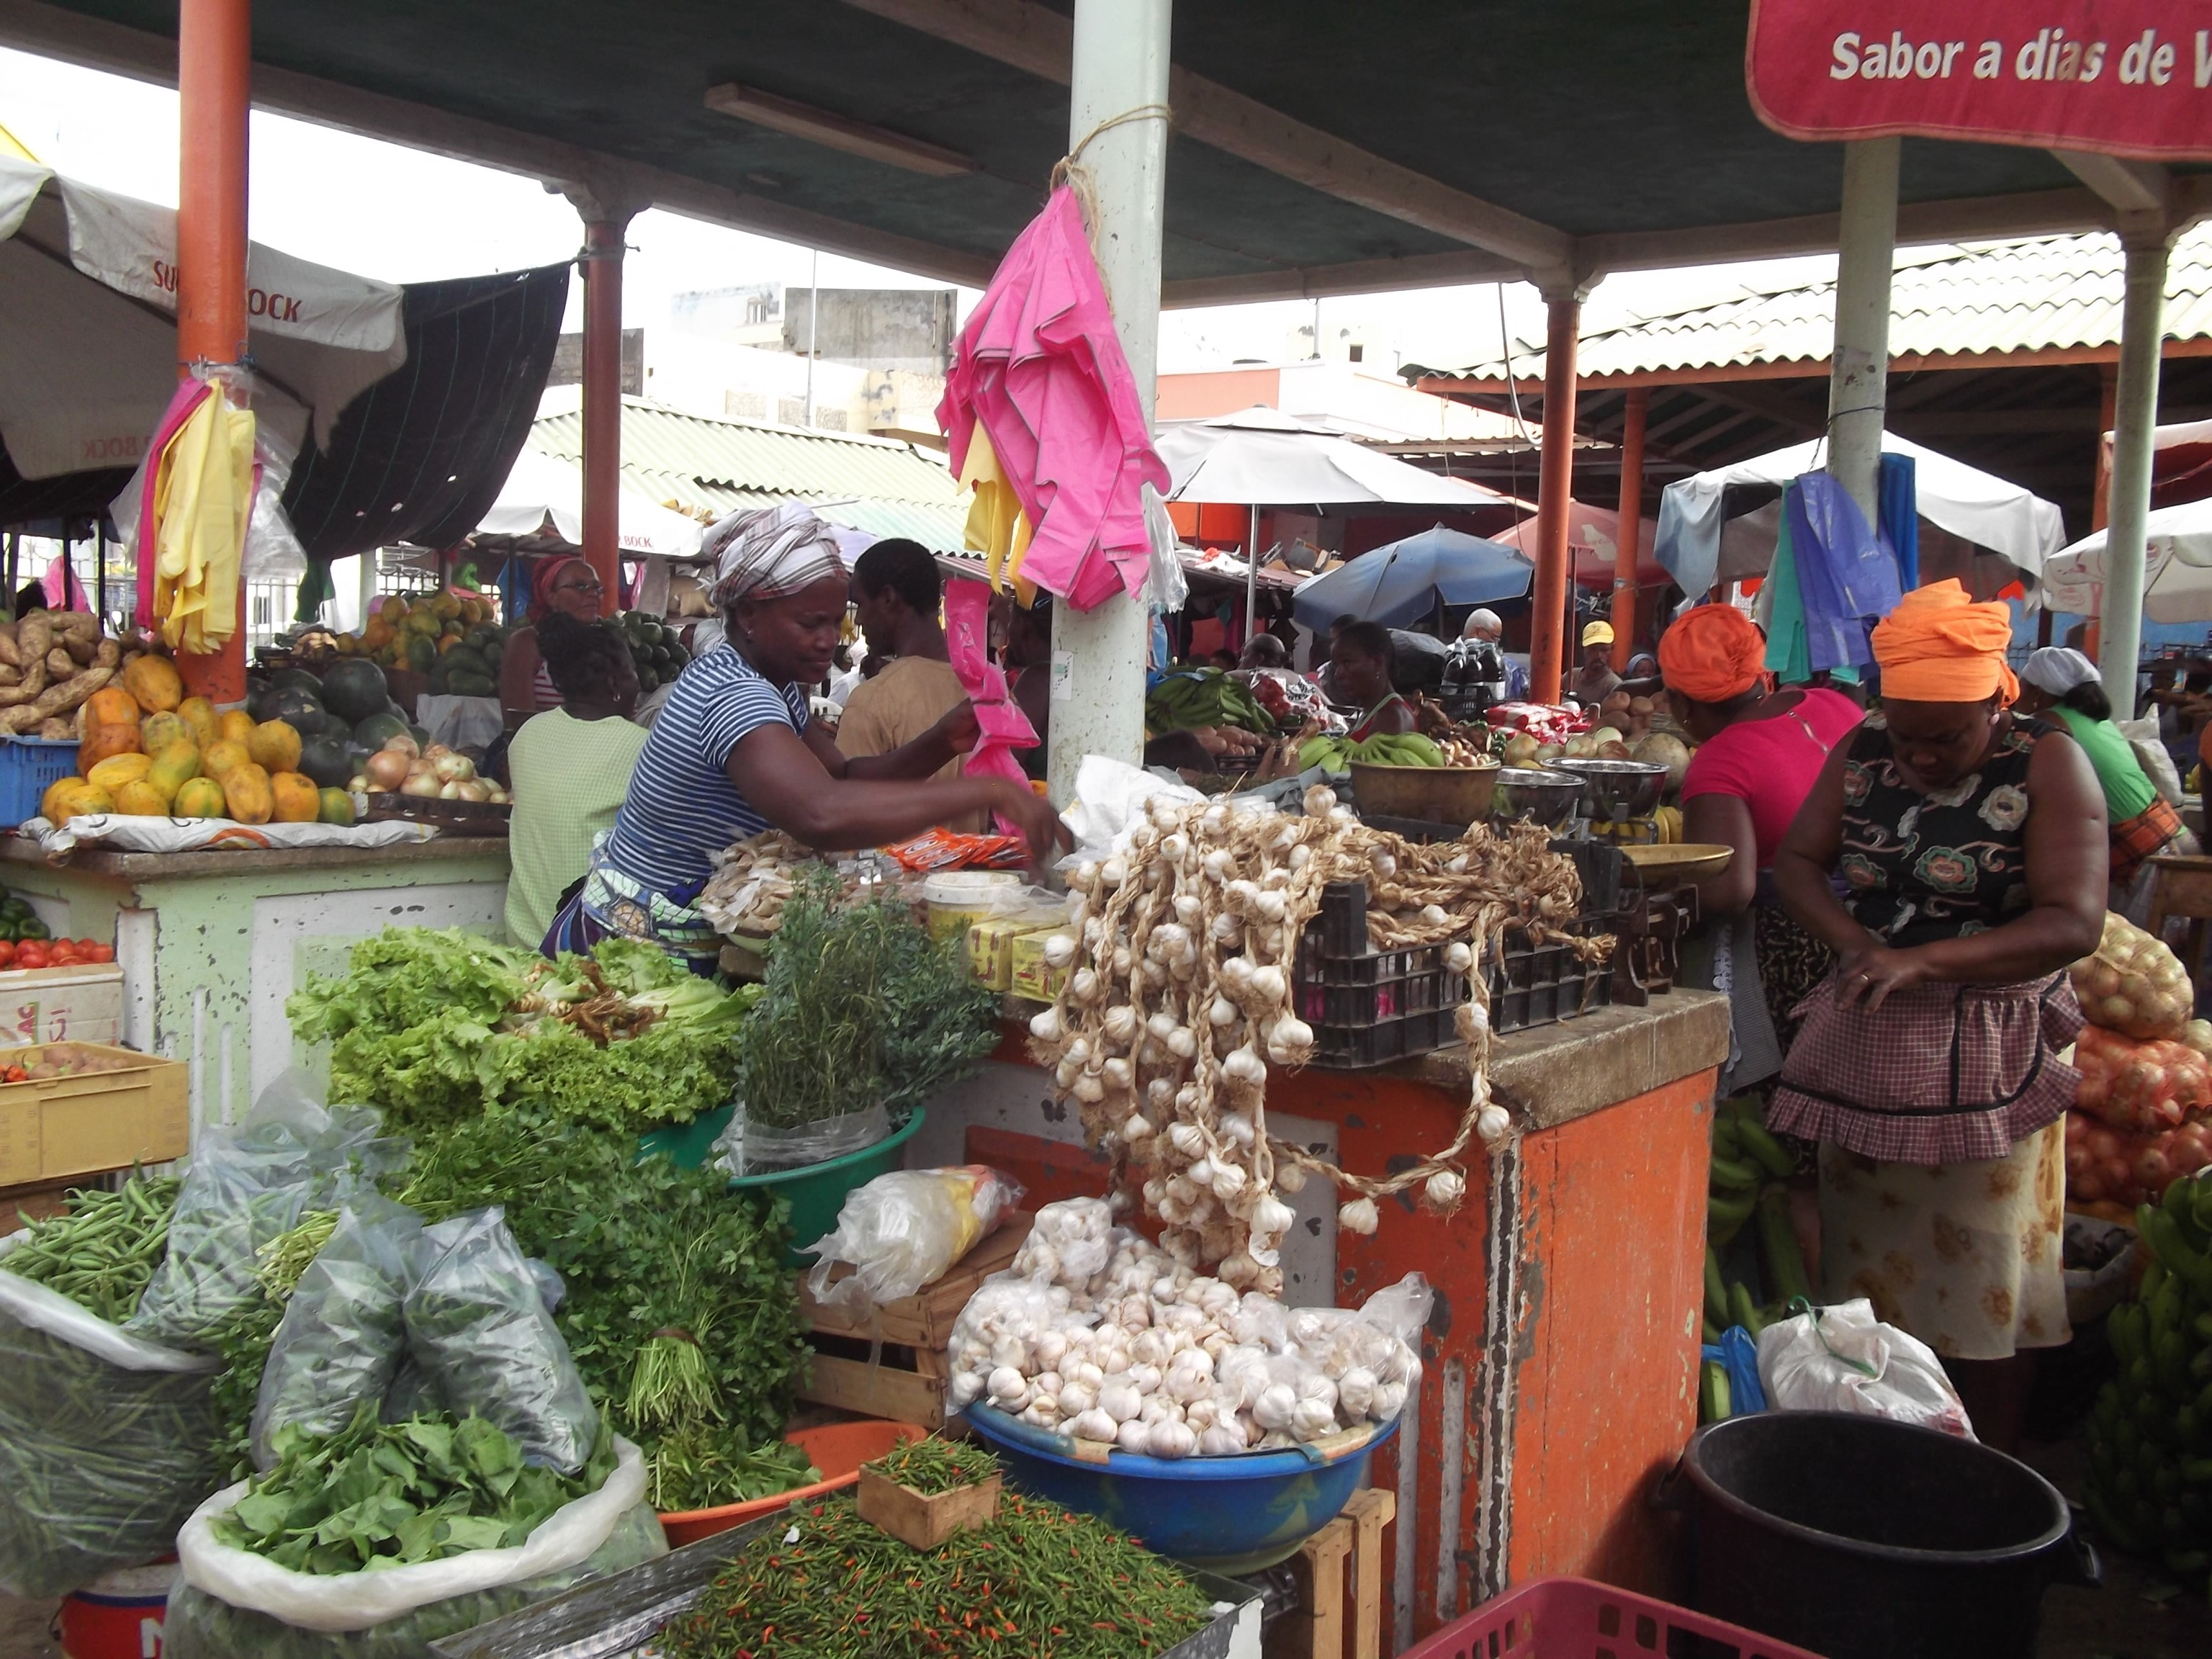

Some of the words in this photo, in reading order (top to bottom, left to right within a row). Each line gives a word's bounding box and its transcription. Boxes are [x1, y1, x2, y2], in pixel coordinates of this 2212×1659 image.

[1830, 30, 1965, 81] Sabor
[1973, 40, 2002, 79] a
[2015, 27, 2107, 83] dias
[2118, 29, 2175, 86] de
[248, 288, 302, 323] OCK
[624, 535, 652, 548] BOCK
